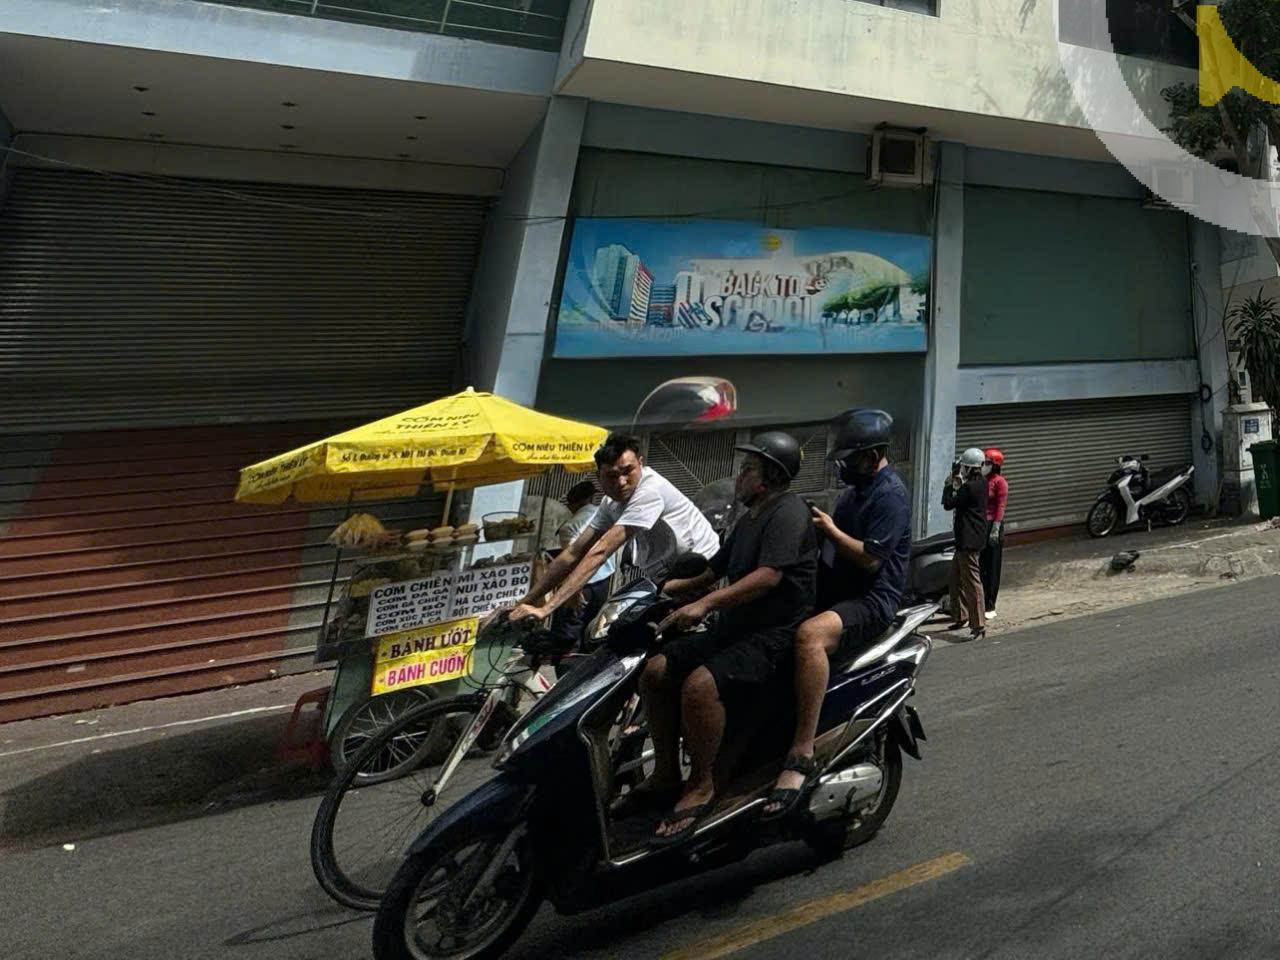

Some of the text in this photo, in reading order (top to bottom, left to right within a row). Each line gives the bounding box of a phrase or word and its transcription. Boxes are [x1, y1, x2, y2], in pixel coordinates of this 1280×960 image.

[374, 584, 406, 599] CƠM
[390, 627, 472, 659] BÁNH ƯỚT
[387, 651, 467, 687] BÁNH CUỐN
